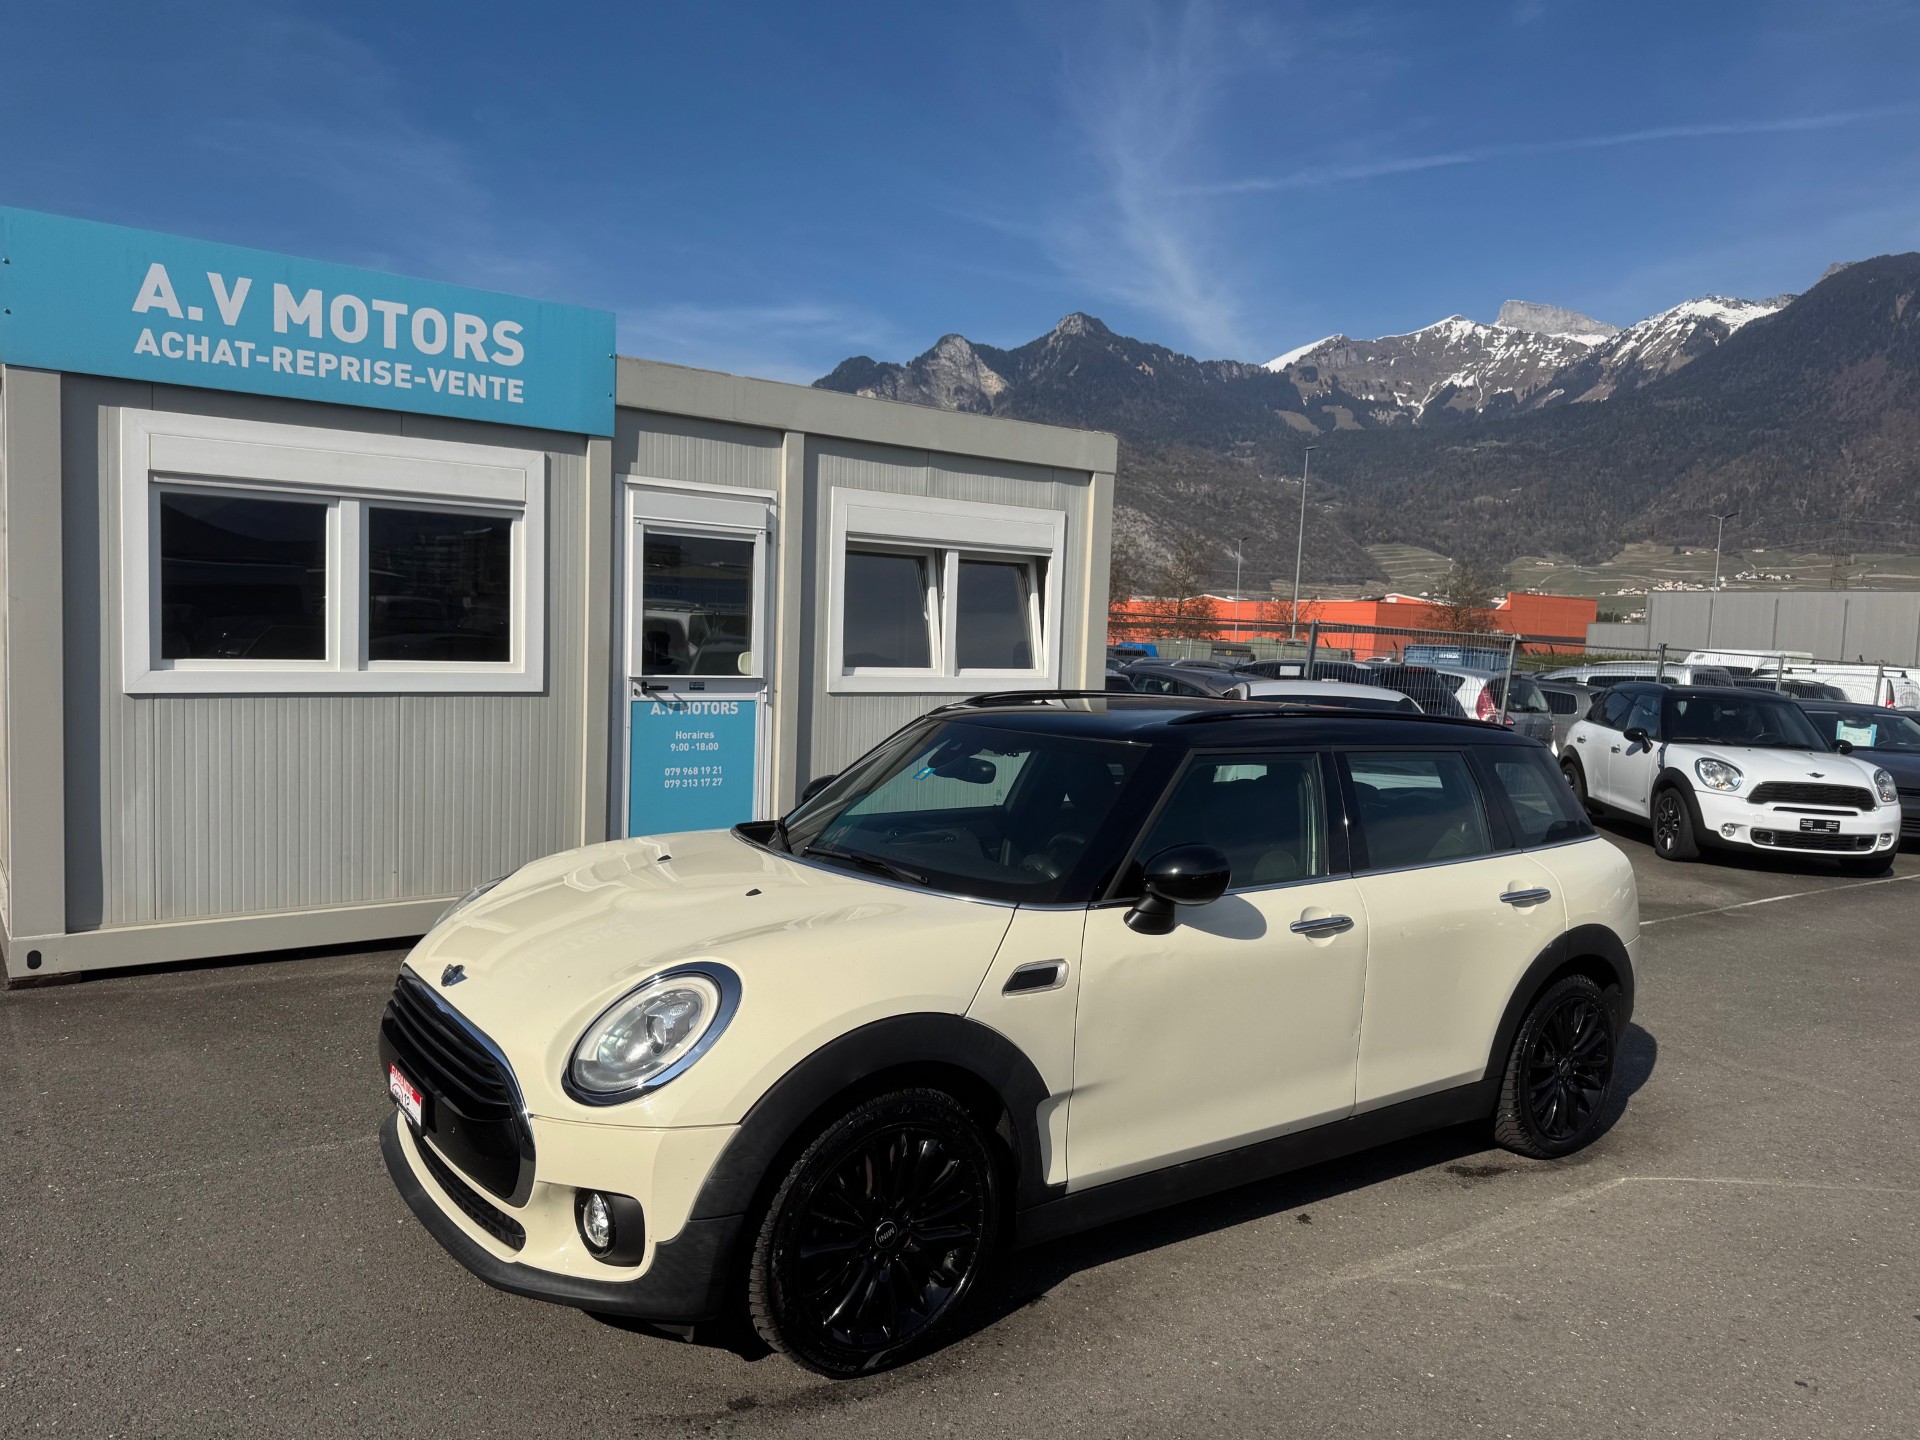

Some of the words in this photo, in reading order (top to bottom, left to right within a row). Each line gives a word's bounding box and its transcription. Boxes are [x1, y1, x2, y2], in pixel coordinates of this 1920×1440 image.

[131, 262, 253, 326] A.V
[273, 282, 525, 367] MOTORS
[133, 327, 525, 404] ACHAT-REPRISE-VENTE
[650, 702, 677, 716] A.V
[679, 702, 739, 715] MOTORS
[675, 731, 715, 740] Horaires
[664, 768, 681, 776] 079
[682, 767, 699, 776] 968
[701, 767, 711, 775] 19
[712, 766, 722, 775] 21
[664, 780, 681, 788] 079
[682, 779, 698, 788] 313
[701, 779, 710, 787] 17
[712, 778, 723, 787] 27
[878, 1226, 895, 1243] MINI
